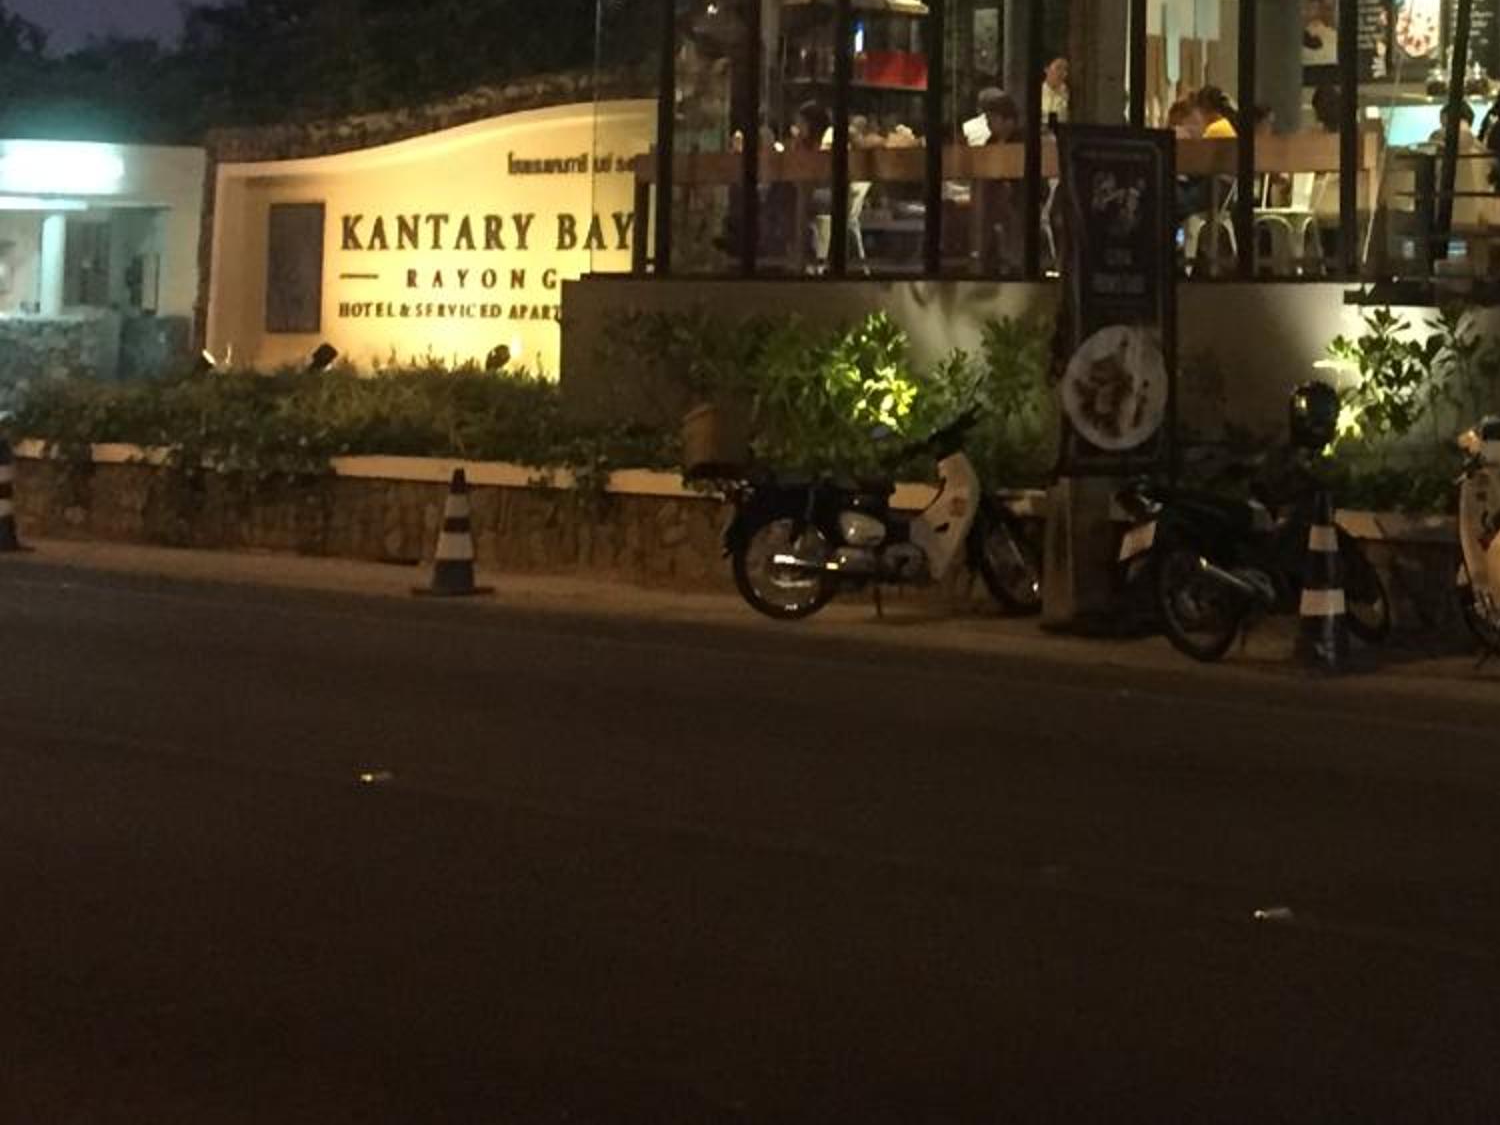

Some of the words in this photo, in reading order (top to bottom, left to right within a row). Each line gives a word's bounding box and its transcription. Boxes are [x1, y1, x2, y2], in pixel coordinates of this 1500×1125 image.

[341, 212, 535, 251] KANTARY
[556, 210, 634, 251] BAY
[406, 268, 557, 289] RAYONG
[339, 302, 395, 318] HOTEL
[415, 303, 503, 319] SERVICED
